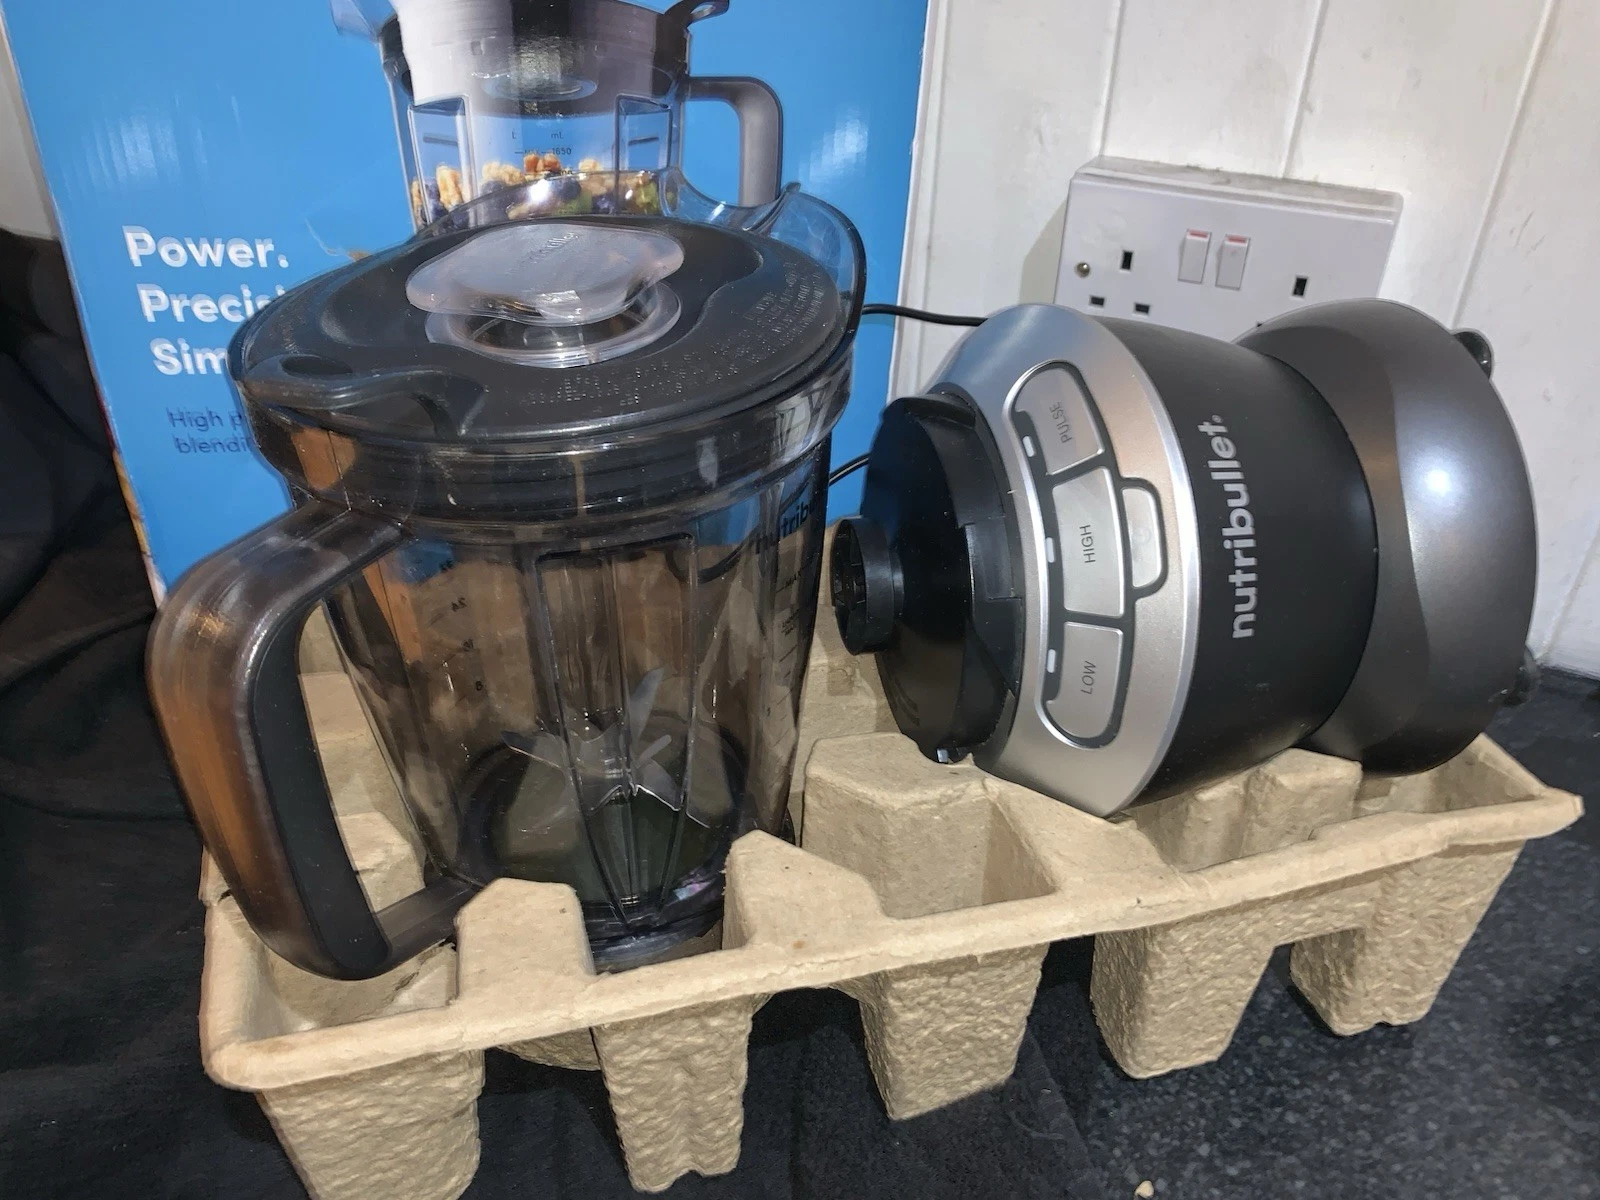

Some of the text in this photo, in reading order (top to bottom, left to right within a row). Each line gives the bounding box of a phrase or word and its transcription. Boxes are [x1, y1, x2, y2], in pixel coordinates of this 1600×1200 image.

[122, 225, 289, 268] Power.
[167, 407, 224, 431] High
[1048, 402, 1072, 443] PULSE
[1079, 523, 1096, 564] HIGH
[1198, 422, 1258, 640] nutribullet
[1080, 661, 1097, 695] LOW
